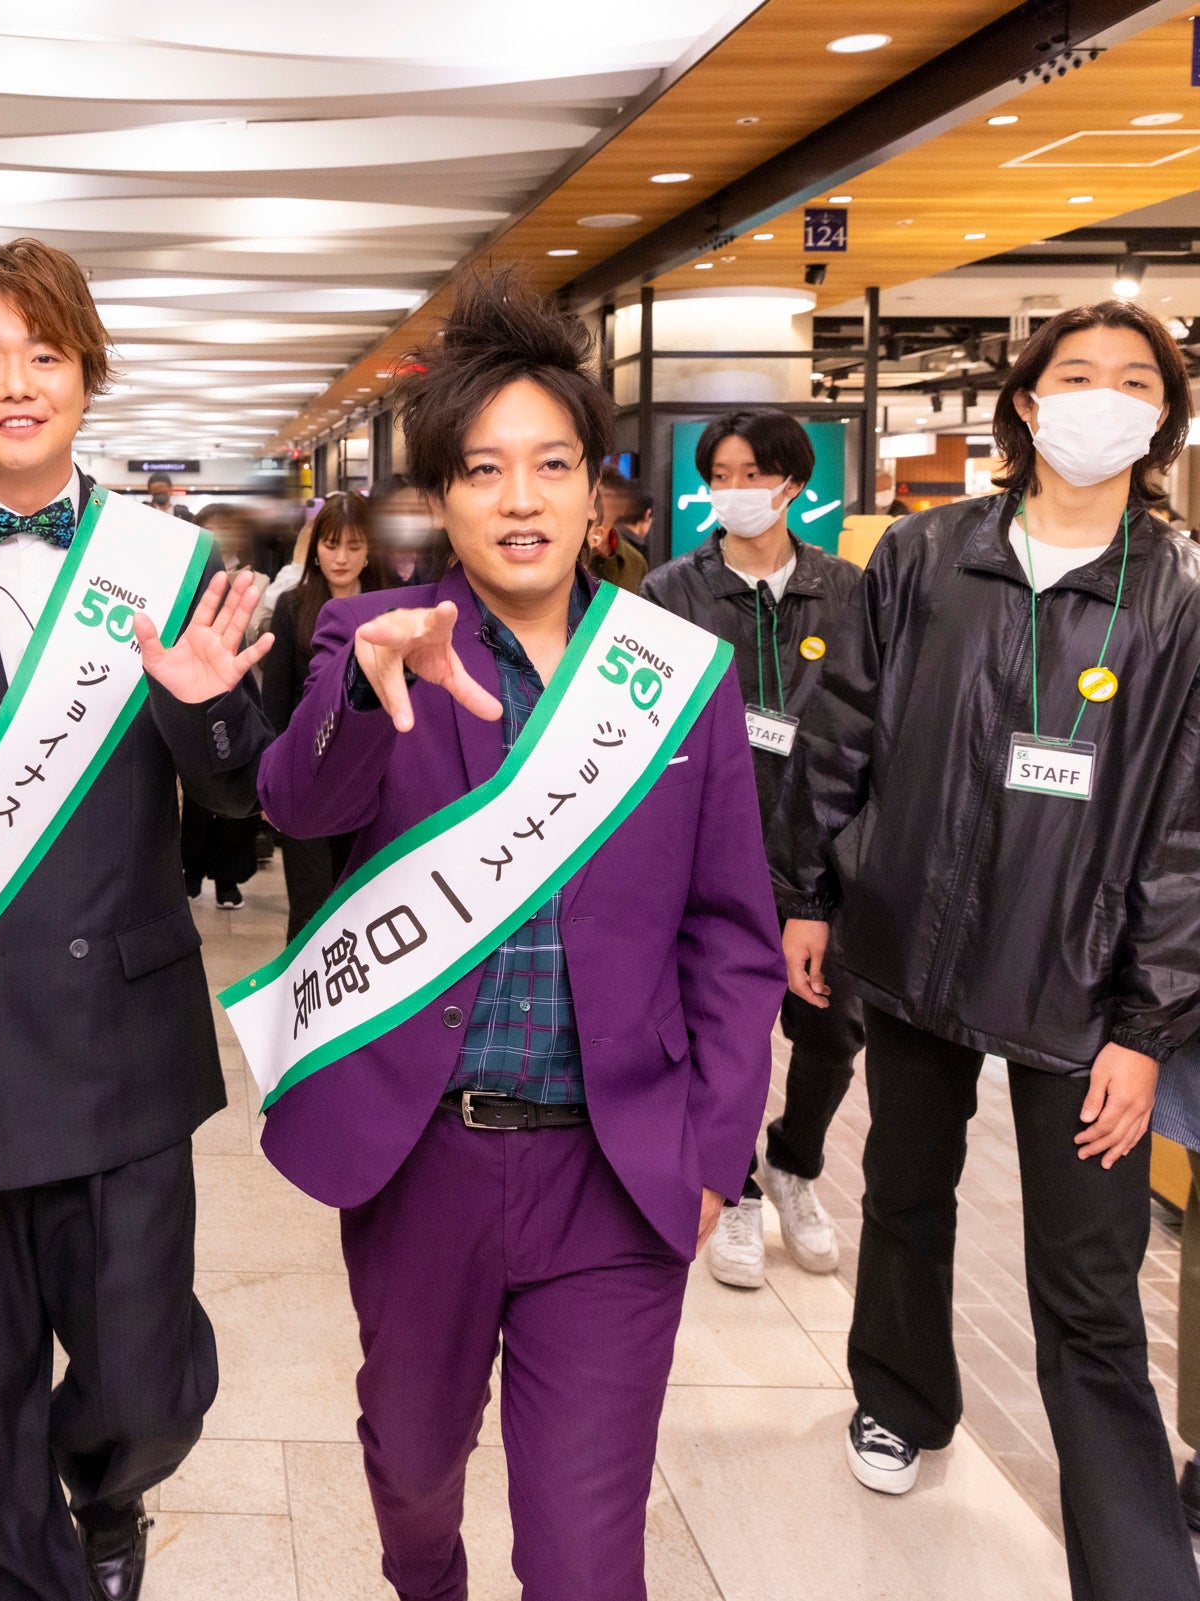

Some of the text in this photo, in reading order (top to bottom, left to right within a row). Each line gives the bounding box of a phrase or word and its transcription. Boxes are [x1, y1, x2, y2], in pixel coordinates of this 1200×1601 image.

[805, 225, 847, 247] 124
[89, 576, 148, 610] JOINUS
[613, 634, 674, 679] JOINUS
[747, 725, 785, 744] STAFF
[1020, 763, 1080, 785] STAFF
